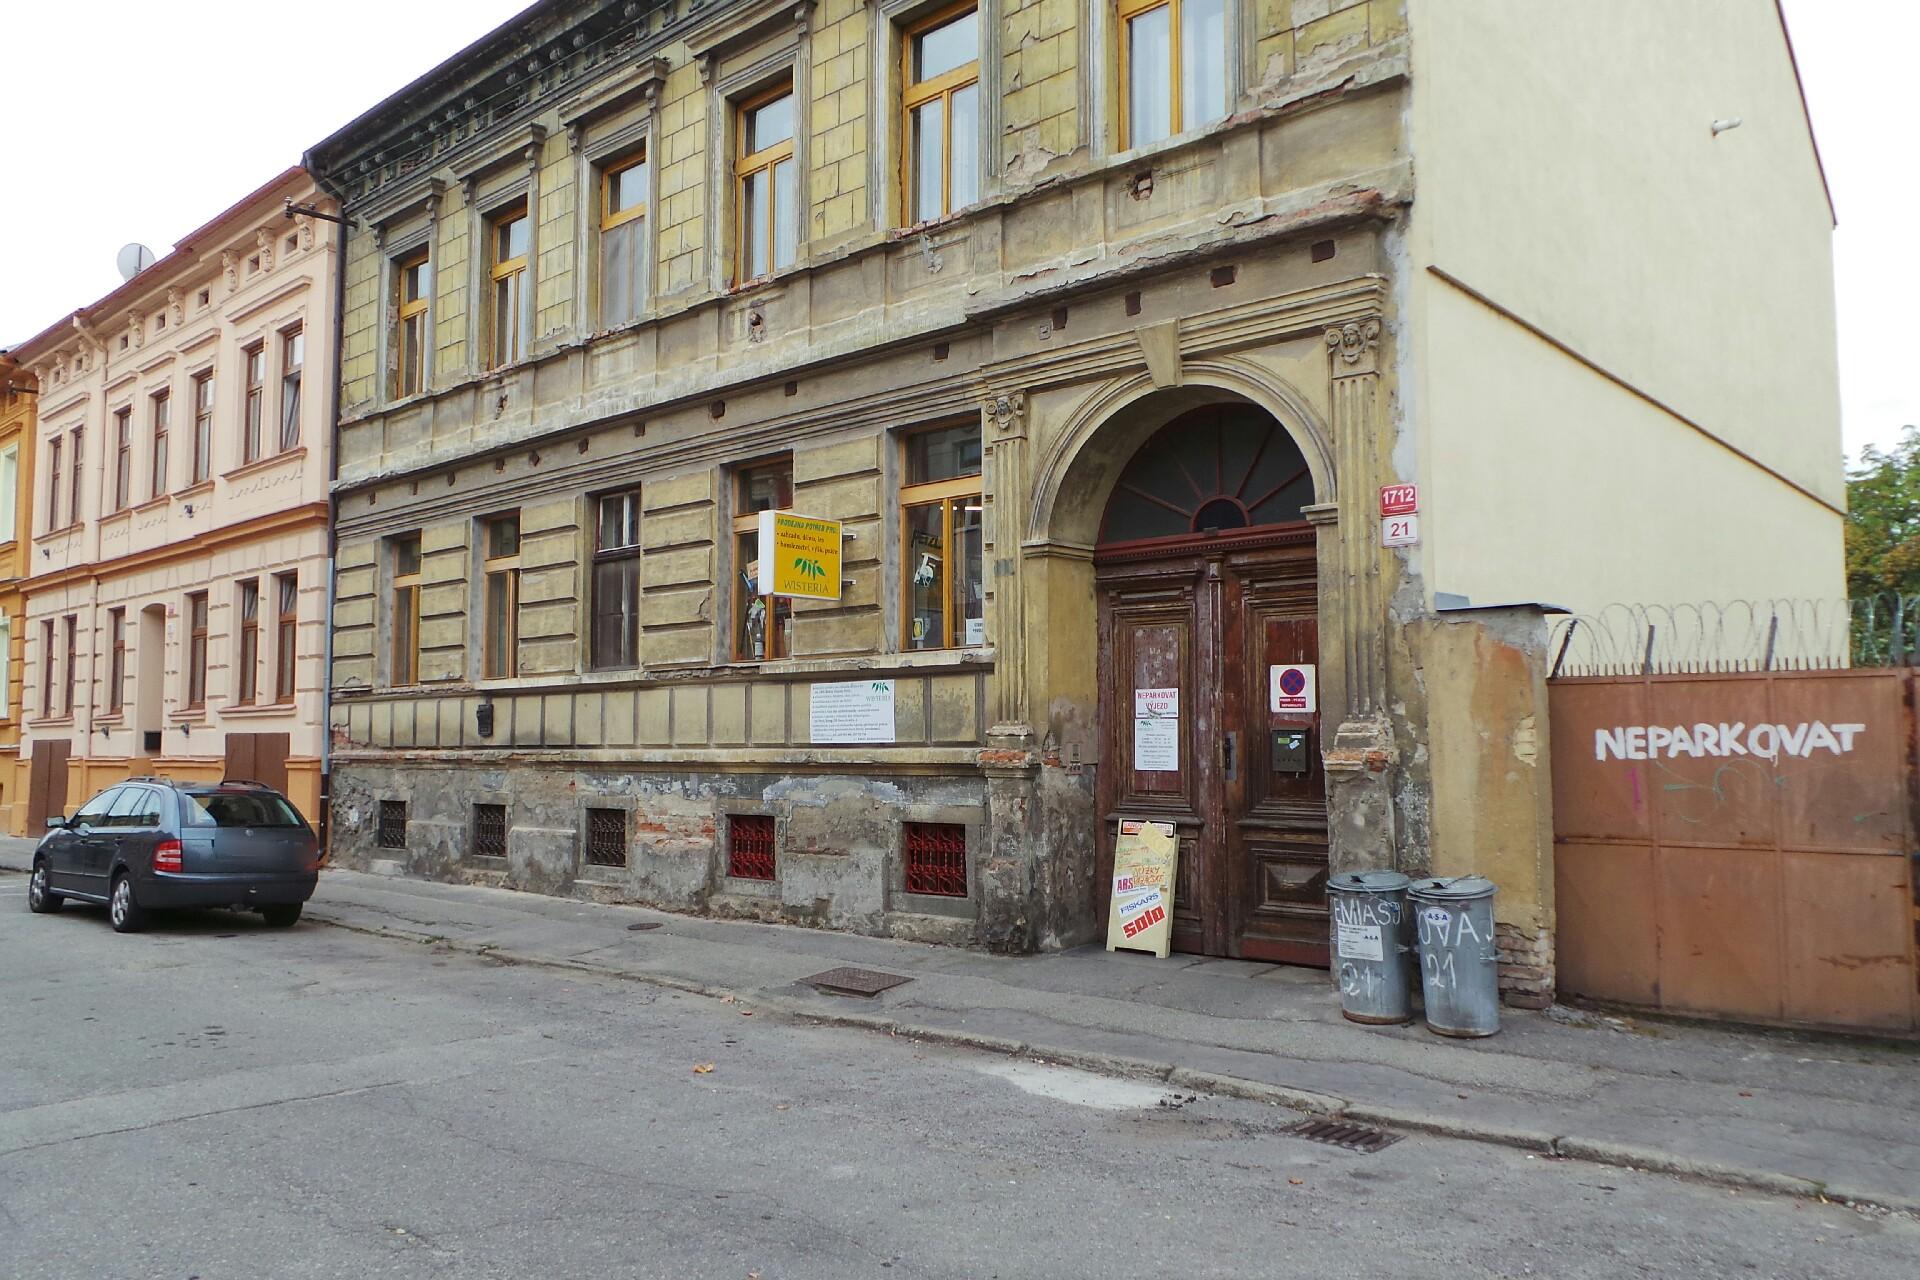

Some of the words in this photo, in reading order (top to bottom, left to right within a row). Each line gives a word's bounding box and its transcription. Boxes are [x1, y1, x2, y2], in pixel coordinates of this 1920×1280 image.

[1383, 488, 1415, 504] 1712
[1391, 522, 1409, 537] 21
[784, 579, 829, 594] WISTERIA
[1137, 691, 1177, 699] NEPARKOVAT
[1594, 720, 1866, 764] NEPARKOVAT
[1117, 877, 1133, 892] ARS
[1120, 892, 1159, 914] FISKARS
[1122, 905, 1166, 938] solo
[1426, 951, 1457, 989] 21
